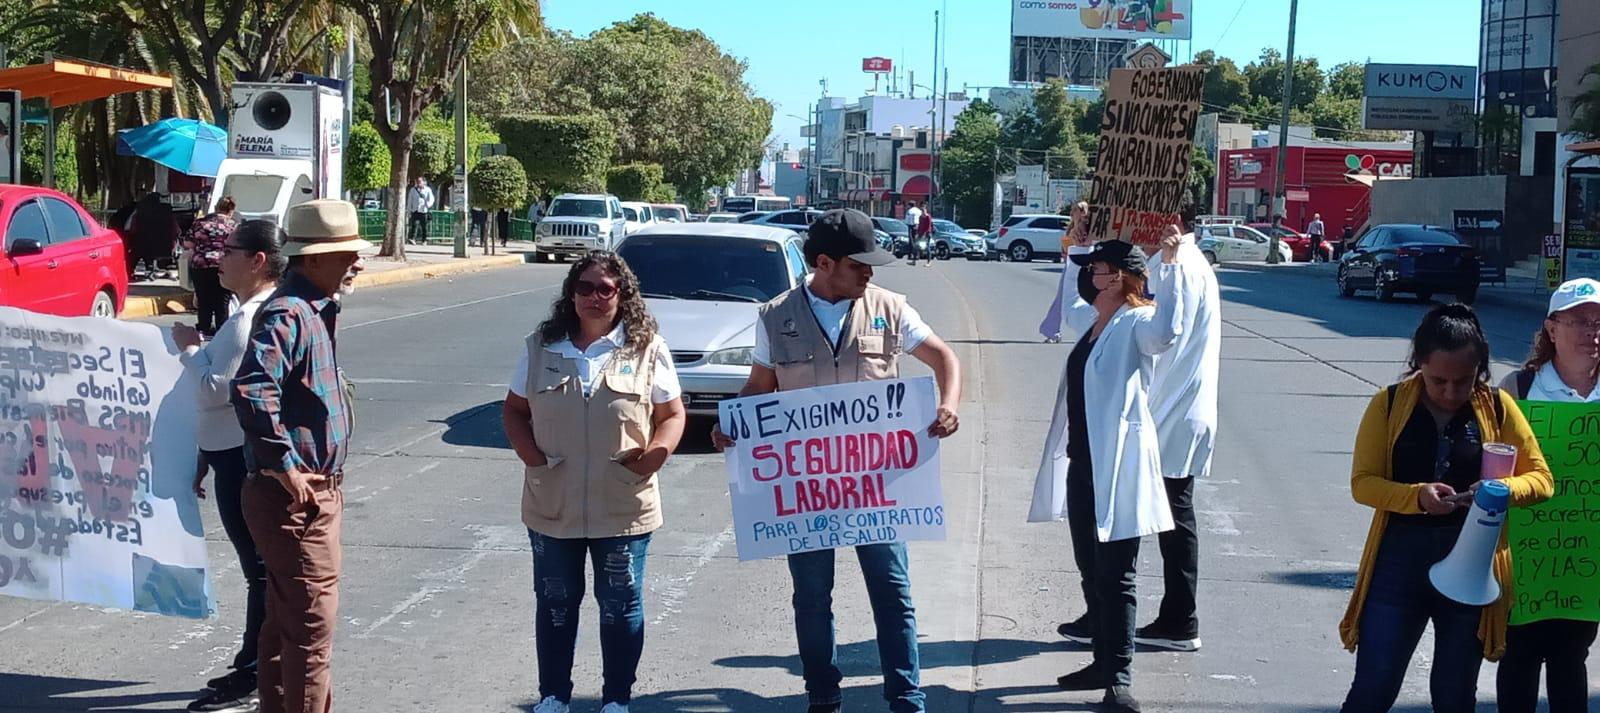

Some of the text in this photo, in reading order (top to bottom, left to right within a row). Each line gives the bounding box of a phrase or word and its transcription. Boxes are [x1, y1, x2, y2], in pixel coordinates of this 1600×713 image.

[1047, 2, 1077, 10] somos
[1378, 71, 1464, 92] KUMON
[239, 144, 274, 153] ELENA
[240, 136, 274, 144] MARÍA
[752, 429, 918, 481] SEGURIDAD
[774, 472, 897, 517] LABORAL
[753, 520, 798, 542] PARA
[845, 505, 944, 528] CONTRATOS
[789, 526, 897, 552] DE LA SALUD
[1517, 528, 1588, 553] se dan
